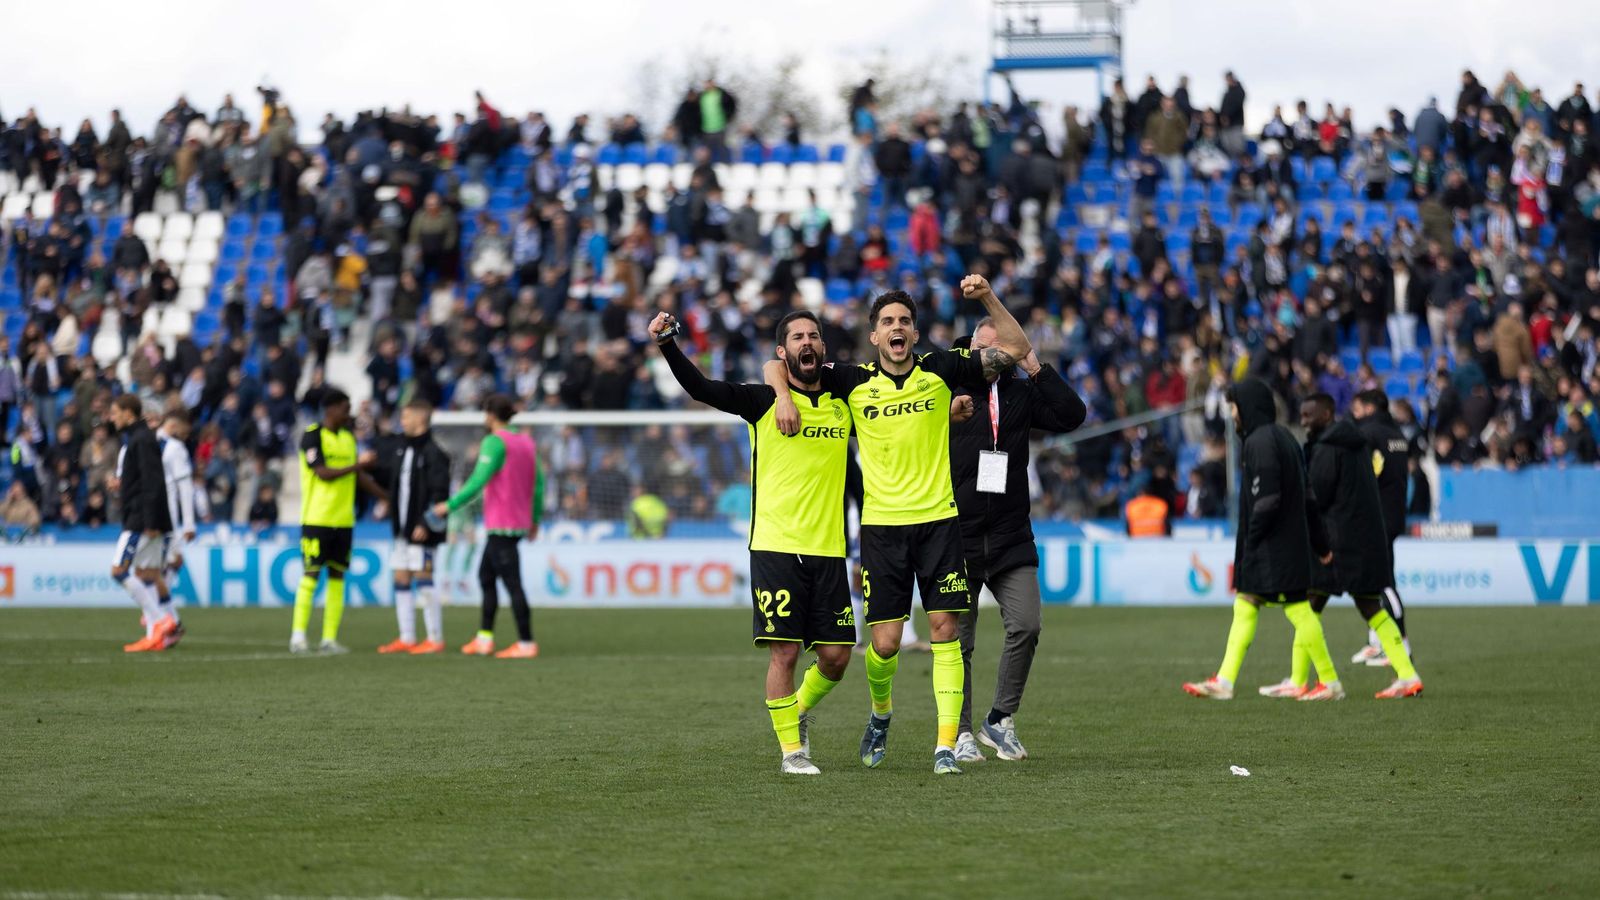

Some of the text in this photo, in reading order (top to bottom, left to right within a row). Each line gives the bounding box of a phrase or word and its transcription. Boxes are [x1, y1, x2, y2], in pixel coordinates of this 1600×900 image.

[883, 398, 936, 417] GREE
[802, 426, 846, 439] GREE
[584, 561, 734, 597] nara
[760, 589, 791, 618] 22
